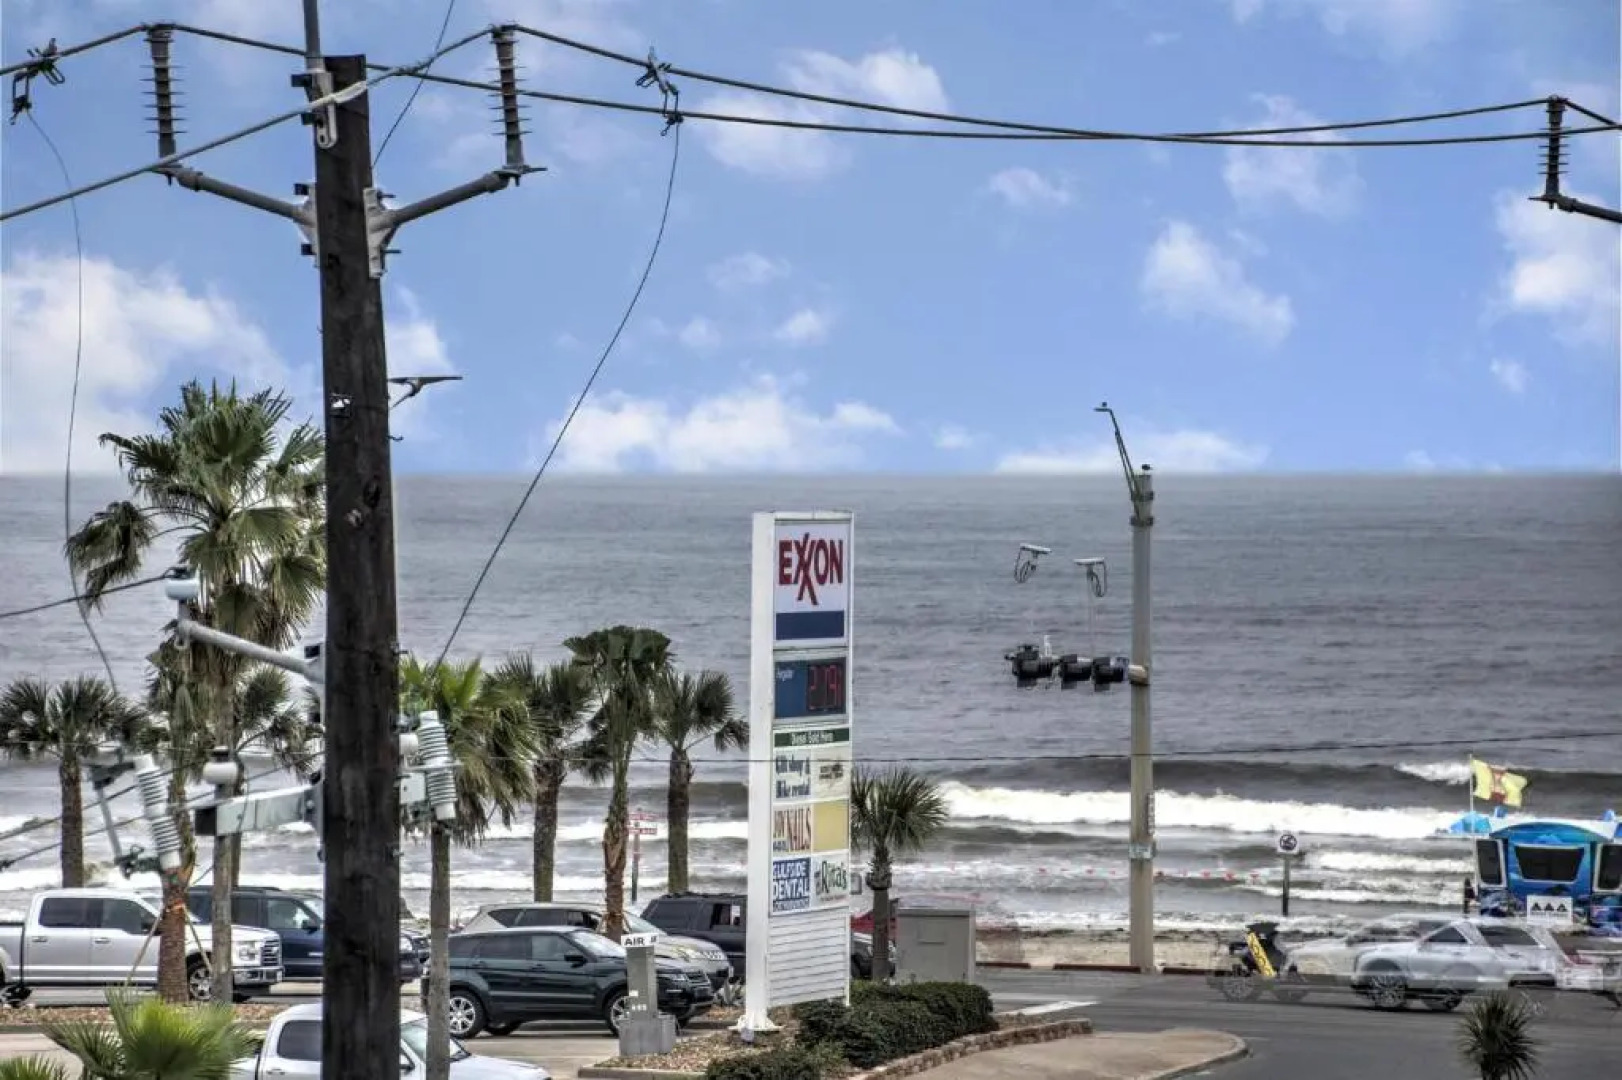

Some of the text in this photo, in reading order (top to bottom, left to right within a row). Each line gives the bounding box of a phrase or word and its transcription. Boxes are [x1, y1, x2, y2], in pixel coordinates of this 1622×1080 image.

[778, 532, 844, 606] EXXON
[773, 878, 810, 900] DENTAL
[624, 937, 645, 946] AIR
